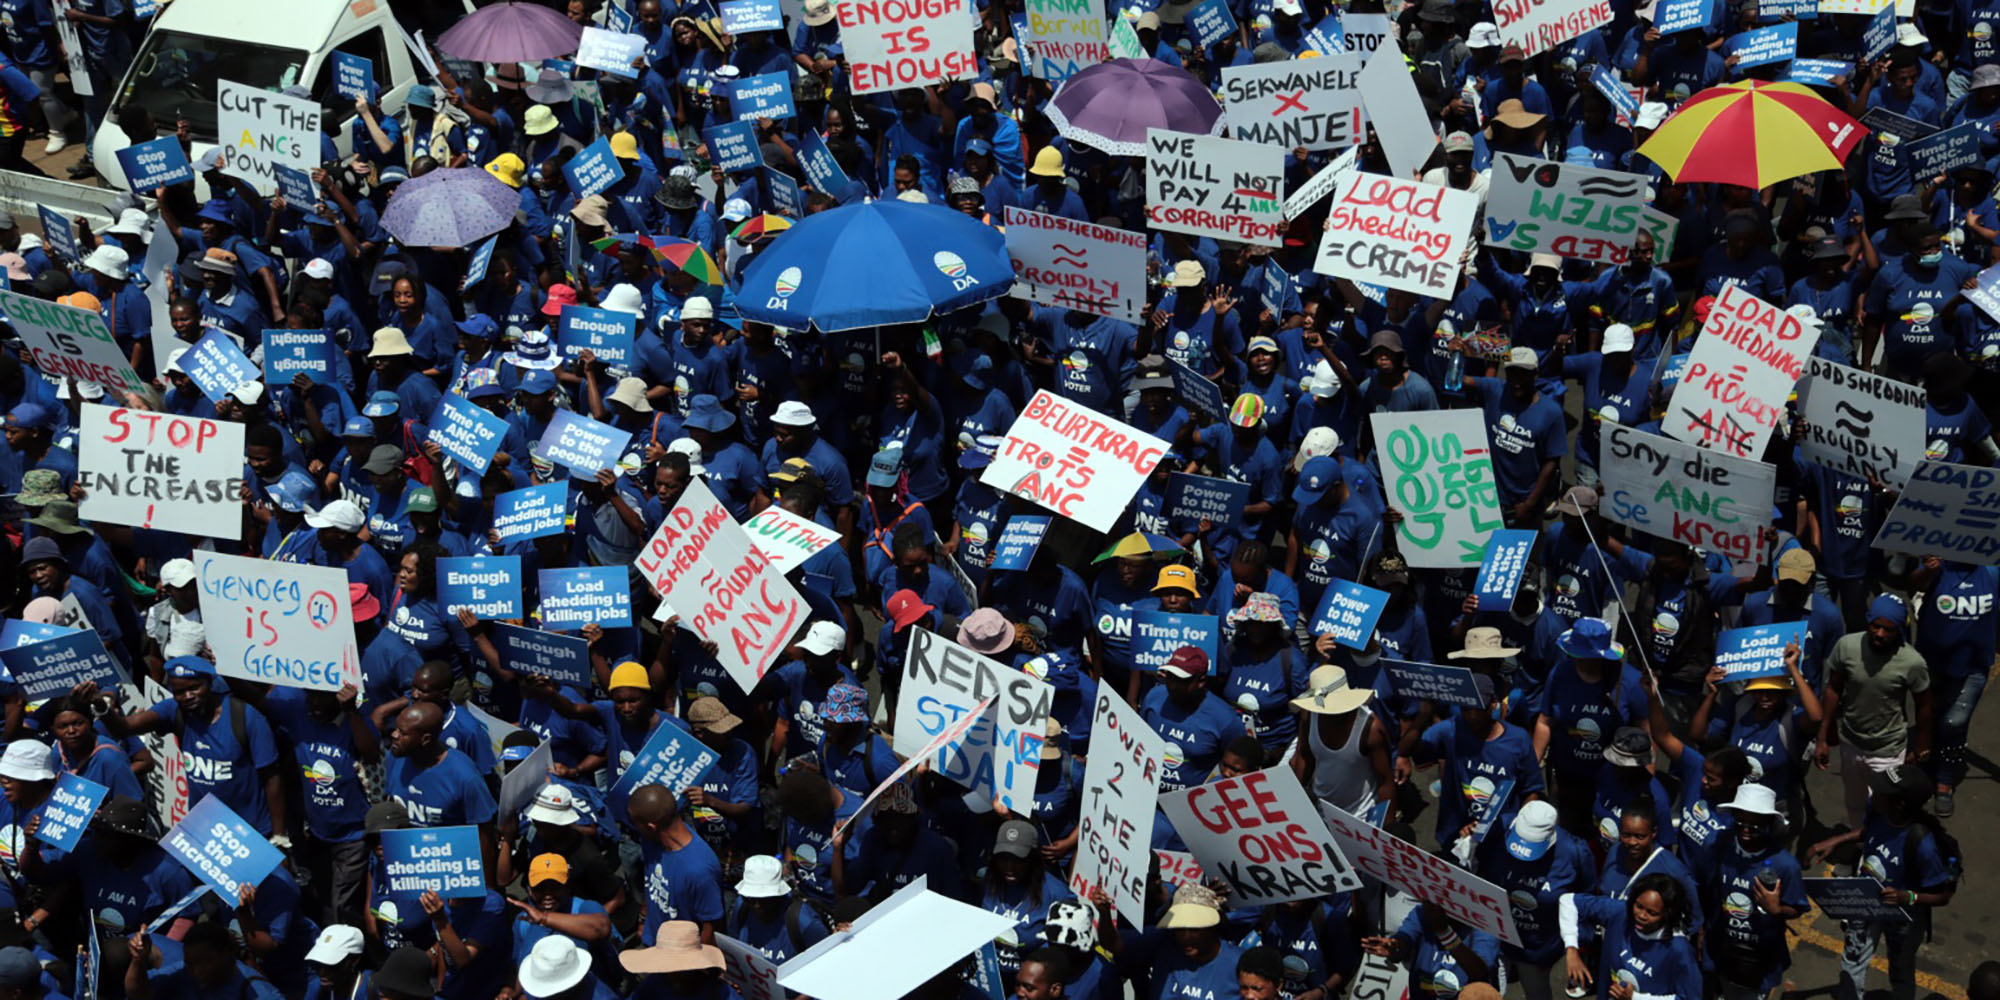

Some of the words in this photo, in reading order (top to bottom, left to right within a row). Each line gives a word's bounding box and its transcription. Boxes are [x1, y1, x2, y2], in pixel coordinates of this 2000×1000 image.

[725, 7, 751, 16] Time
[755, 4, 773, 12] for
[839, 0, 961, 27] ENOUGH
[1194, 7, 1218, 27] Power
[1678, 7, 1698, 19] the
[727, 19, 779, 31] shedding
[1659, 16, 1702, 34] people!
[880, 27, 931, 54] IS
[1750, 33, 1778, 44] Load
[339, 62, 364, 77] Power
[852, 51, 978, 91] ENOUGH
[350, 76, 364, 87] the
[737, 84, 782, 100] Enough
[1227, 71, 1358, 103] SEKWANELE
[220, 88, 267, 118] CUT
[273, 104, 319, 131] THE
[739, 104, 788, 121] enough!
[1238, 107, 1361, 148] MANJE!
[715, 134, 744, 147] Power
[732, 145, 747, 156] the
[1152, 137, 1194, 157] WE
[136, 151, 166, 165] Stop
[1912, 146, 1945, 160] Time
[146, 162, 166, 172] the
[574, 153, 601, 177] Power
[590, 166, 606, 180] the
[1915, 152, 1977, 181] shedding
[1151, 159, 1219, 184] WILL
[1234, 173, 1281, 195] NOT
[1161, 181, 1210, 207] PAY
[1222, 194, 1246, 214] 4
[1529, 189, 1640, 233] STEM
[1149, 206, 1283, 238] CORRUPTION
[1487, 217, 1540, 250] SA
[953, 274, 979, 291] DA
[1012, 258, 1120, 298] PROUDLY
[766, 297, 788, 310] DA
[1718, 285, 1803, 341] LOAD
[1, 293, 112, 343] GENOEG
[570, 318, 626, 335] Enough
[49, 332, 82, 355] IS
[270, 333, 326, 346] enough!
[590, 333, 602, 344] is
[1705, 312, 1803, 382] SHEDDING
[1902, 335, 1934, 343] VOTER
[202, 339, 227, 364] Save
[274, 359, 327, 373] Enough
[191, 367, 218, 391] ANC
[1064, 382, 1092, 393] VOTER
[103, 408, 218, 453] STOP
[442, 404, 472, 428] Time
[474, 422, 496, 440] for
[1515, 425, 1532, 438] DA
[564, 424, 611, 445] Power
[1024, 392, 1162, 476] BEURTKRAG
[428, 428, 486, 470] shedding
[560, 435, 572, 446] to
[579, 441, 601, 457] the
[1802, 422, 1900, 469] PROUDLY
[121, 448, 180, 477] THE
[547, 446, 603, 470] people!
[1005, 436, 1096, 489] TROTS
[80, 471, 242, 501] INCREASE
[1912, 465, 1994, 488] LOAD
[1011, 470, 1084, 517] ANC
[1182, 485, 1231, 500] Power
[1655, 481, 1741, 524] ANC
[514, 496, 545, 511] Load
[1181, 496, 1198, 507] to
[1202, 499, 1226, 511] the
[1613, 491, 1651, 525] Se
[494, 507, 550, 526] shedding
[534, 517, 562, 532] jobs
[1172, 506, 1230, 523] people!
[1843, 516, 1862, 528] DA
[640, 506, 694, 573] LOAD
[656, 504, 728, 595] SHEDDING
[968, 546, 986, 558] DA
[448, 572, 509, 586] Enough
[1310, 562, 1327, 575] DA
[1482, 545, 1504, 593] Power
[1503, 541, 1528, 599] people!
[472, 588, 486, 600] is
[566, 581, 604, 592] Load
[693, 543, 771, 638] PROUDLY
[544, 592, 611, 609] shedding
[616, 591, 629, 603] is
[1332, 592, 1370, 614] Power
[1937, 593, 1993, 616] ONE
[546, 610, 592, 623] killing
[596, 608, 628, 620] jobs
[731, 579, 785, 665] ANC
[1328, 606, 1341, 620] to
[1342, 612, 1362, 626] the
[1138, 623, 1179, 638] Time
[1183, 627, 1208, 641] for
[1315, 620, 1361, 642] people!
[1740, 634, 1779, 648] Load
[33, 648, 77, 667] Load
[509, 637, 576, 659] Enough
[510, 659, 580, 682] enough!
[536, 654, 550, 666] is
[16, 659, 88, 684] shedding
[908, 626, 1000, 709] RED
[1007, 678, 1052, 726] SA
[1391, 668, 1435, 683] Time
[24, 675, 76, 696] killing
[1245, 678, 1261, 690] AM
[1398, 689, 1477, 706] shedding
[1095, 694, 1158, 786] POWER
[1169, 728, 1185, 739] AM
[1107, 761, 1124, 798] 2
[53, 787, 74, 804] Save
[1187, 772, 1289, 835] GEE
[45, 805, 63, 821] vote
[1090, 786, 1136, 851] THE
[42, 823, 67, 840] ANC
[210, 822, 250, 859] Stop
[204, 840, 233, 867] the
[410, 843, 452, 858] Load
[1238, 824, 1322, 864] ONS
[1510, 842, 1533, 858] ONE
[170, 832, 242, 897] increase!
[387, 859, 461, 875] shedding
[463, 857, 480, 872] is
[1081, 816, 1144, 904] PEOPLE
[1218, 842, 1355, 900] KRAG!
[391, 874, 441, 891] killing
[444, 874, 480, 891] jobs
[1729, 917, 1752, 930] DA
